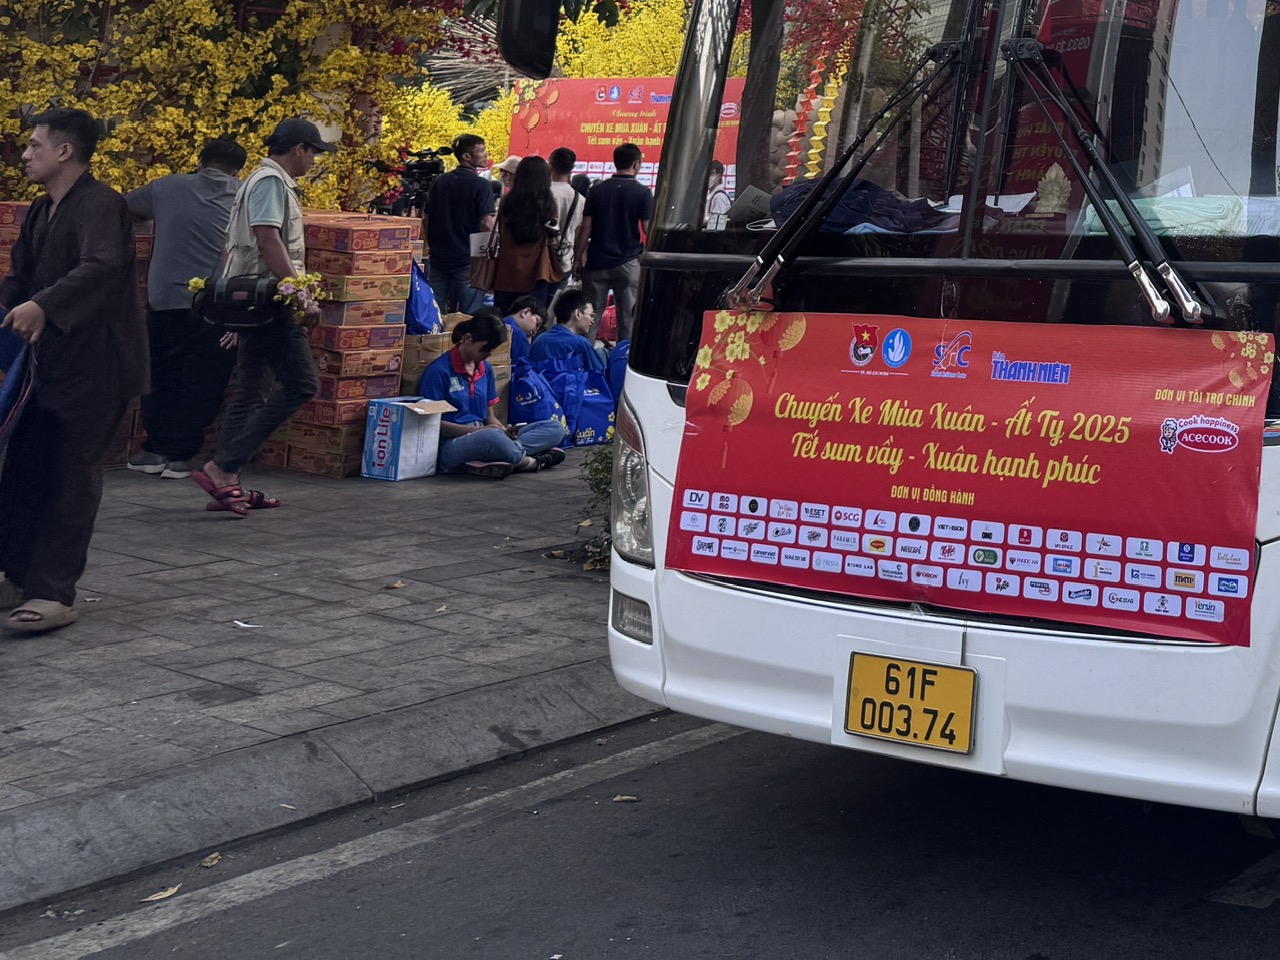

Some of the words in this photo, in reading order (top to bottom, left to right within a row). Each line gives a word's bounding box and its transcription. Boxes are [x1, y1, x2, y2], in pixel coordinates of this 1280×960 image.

[606, 123, 614, 133] XE
[991, 360, 1039, 382] THANH
[1039, 361, 1071, 384] NIÊN
[1155, 389, 1174, 400] ĐƠN
[1176, 389, 1185, 405] VỊ
[1188, 389, 1202, 403] TÀI
[1206, 392, 1225, 407] TRỢ
[1225, 393, 1256, 407] CHÍNH
[377, 407, 391, 436] Life
[774, 392, 843, 428] Chuyến
[848, 397, 873, 424] Xe
[878, 399, 924, 428] Mùa
[930, 402, 986, 433] Xuân
[1005, 396, 1036, 438] Ất
[1037, 409, 1065, 446] Tỵ
[1069, 411, 1132, 444] 2025
[1178, 418, 1199, 428] Cook
[1200, 415, 1239, 433] happiness
[791, 429, 820, 458] Tết
[820, 443, 862, 463] sum
[866, 435, 905, 475] vầy
[922, 442, 980, 474] Xuân
[982, 452, 1042, 482] hạnh
[1042, 453, 1102, 488] phúc
[891, 485, 909, 500] ĐƠN
[912, 487, 921, 502] VỊ
[923, 484, 948, 503] ĐỒNG
[950, 487, 975, 505] HÀNH
[843, 512, 860, 522] SCG
[1195, 600, 1216, 612] Yersin
[885, 663, 938, 701] 61F
[860, 697, 956, 745] 003.74
